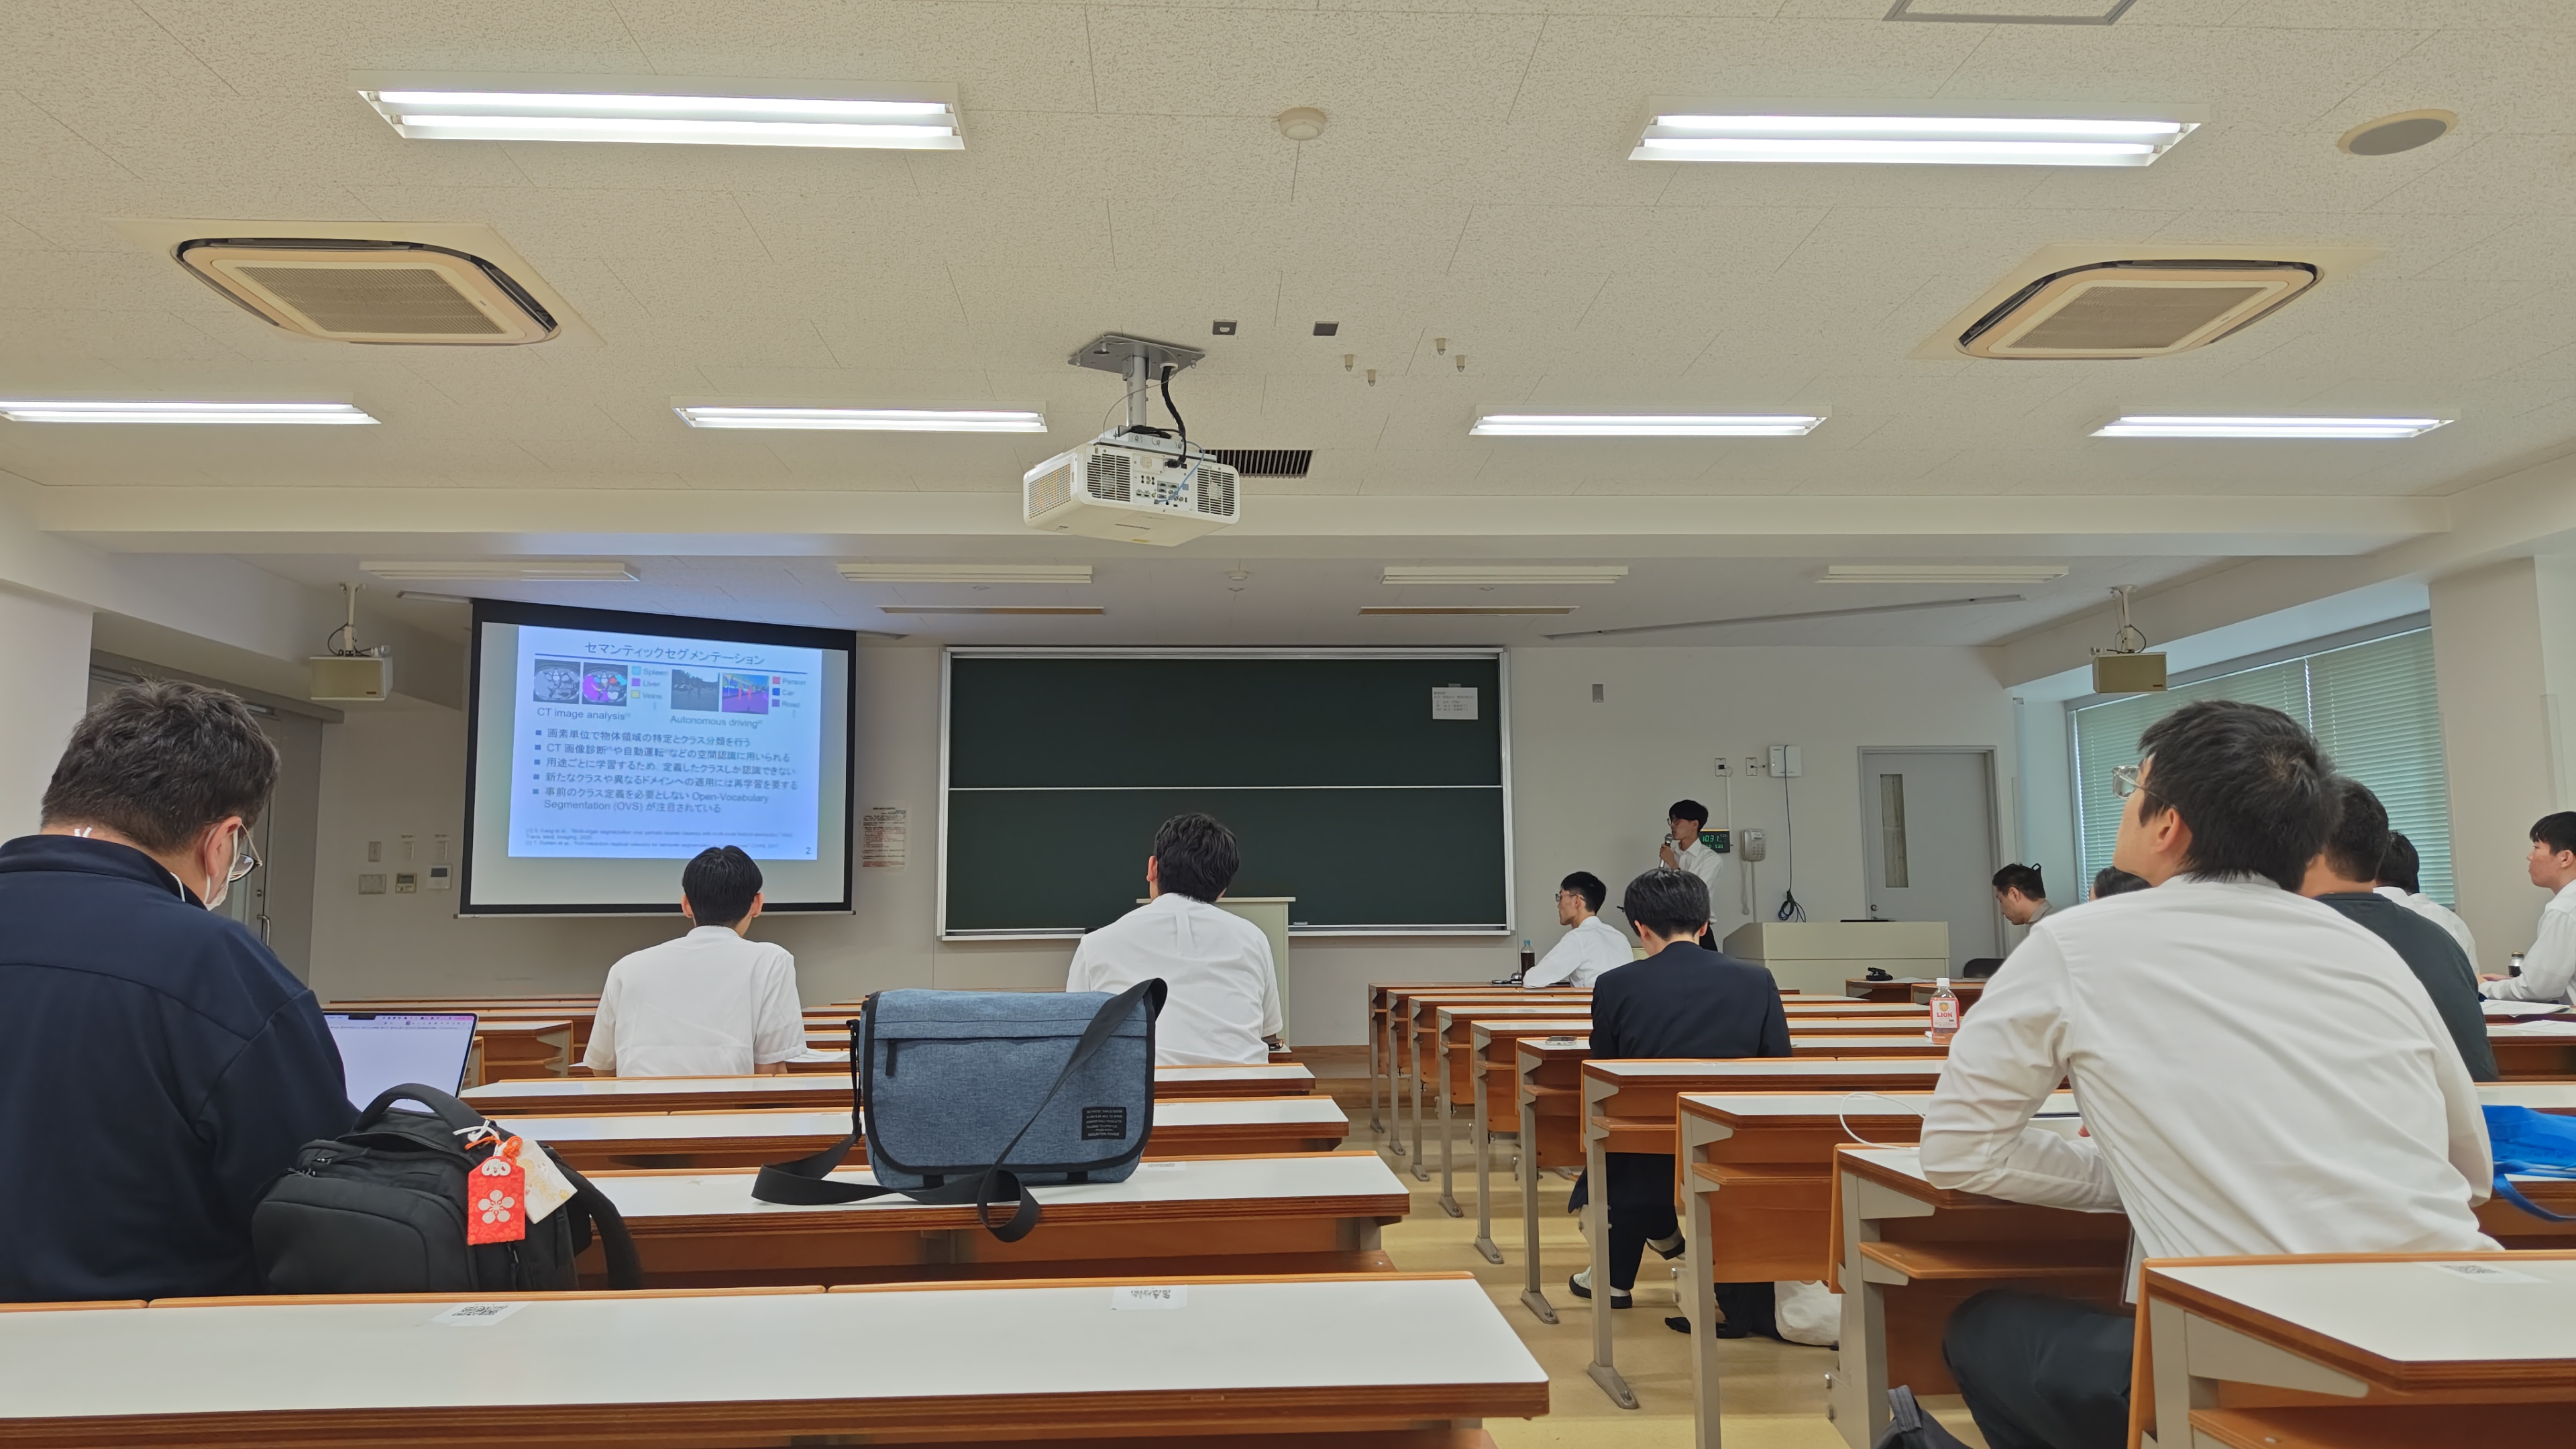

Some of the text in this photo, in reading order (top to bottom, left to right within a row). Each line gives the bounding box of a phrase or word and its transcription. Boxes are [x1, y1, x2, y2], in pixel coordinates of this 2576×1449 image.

[585, 642, 765, 665] セマンティックセグメンテーション
[643, 668, 669, 676] Spleen
[537, 707, 552, 716] CT
[554, 708, 584, 720] image
[670, 715, 727, 726] Autonomous
[547, 728, 750, 747] 画素単位で物体領域の特定とクラス分類を行う
[545, 772, 798, 790] 新たなクラスや異なるドメインへの適用には再学習を要する
[545, 787, 769, 804] 事前のクラス定義を必要としない Open-Vocabulary
[544, 800, 721, 813] Segmentation (OVS) が注目されている
